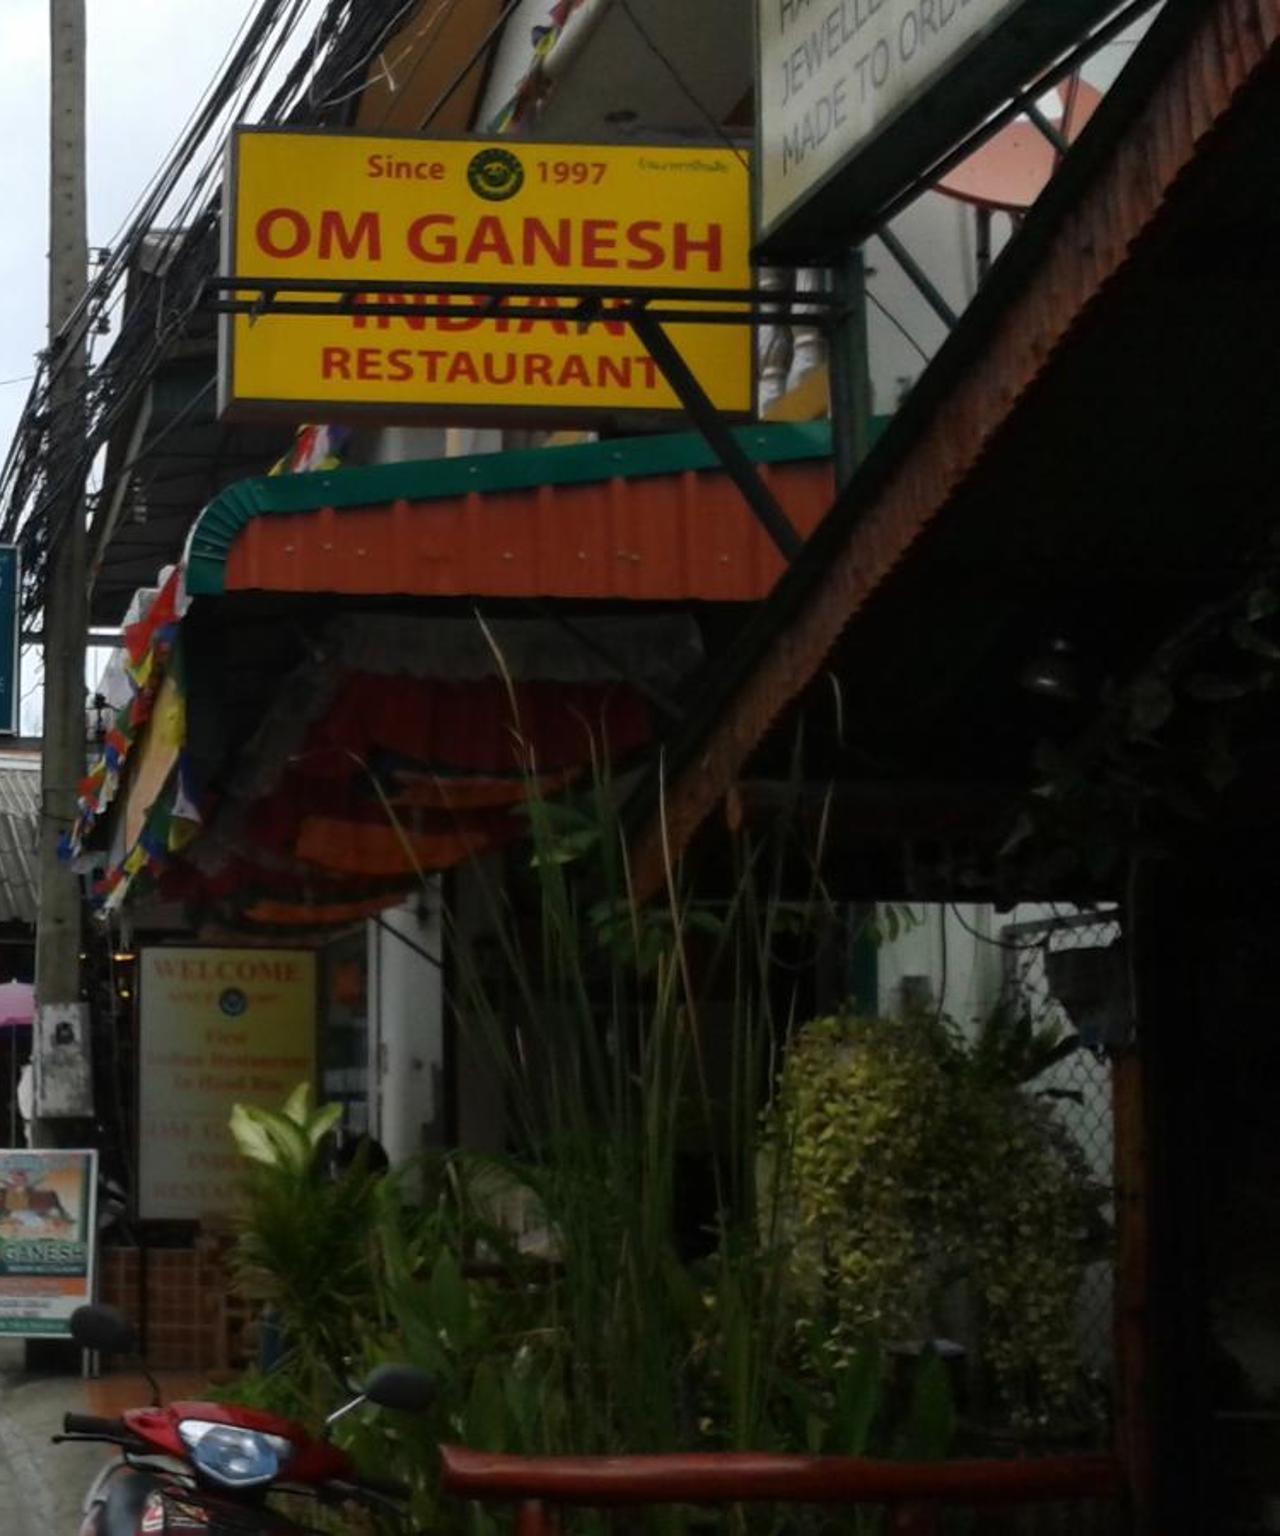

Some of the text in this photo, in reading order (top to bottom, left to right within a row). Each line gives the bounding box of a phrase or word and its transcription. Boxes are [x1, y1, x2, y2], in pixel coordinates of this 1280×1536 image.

[782, 0, 884, 104] JEWELL
[782, 0, 973, 176] MADE TO ORD
[366, 154, 446, 181] Since
[537, 161, 608, 186] 1997
[254, 207, 722, 273] OM GANESH
[321, 347, 662, 389] RESTAURANT
[153, 959, 304, 982] WELCOME
[2, 1242, 86, 1264] GANESH
